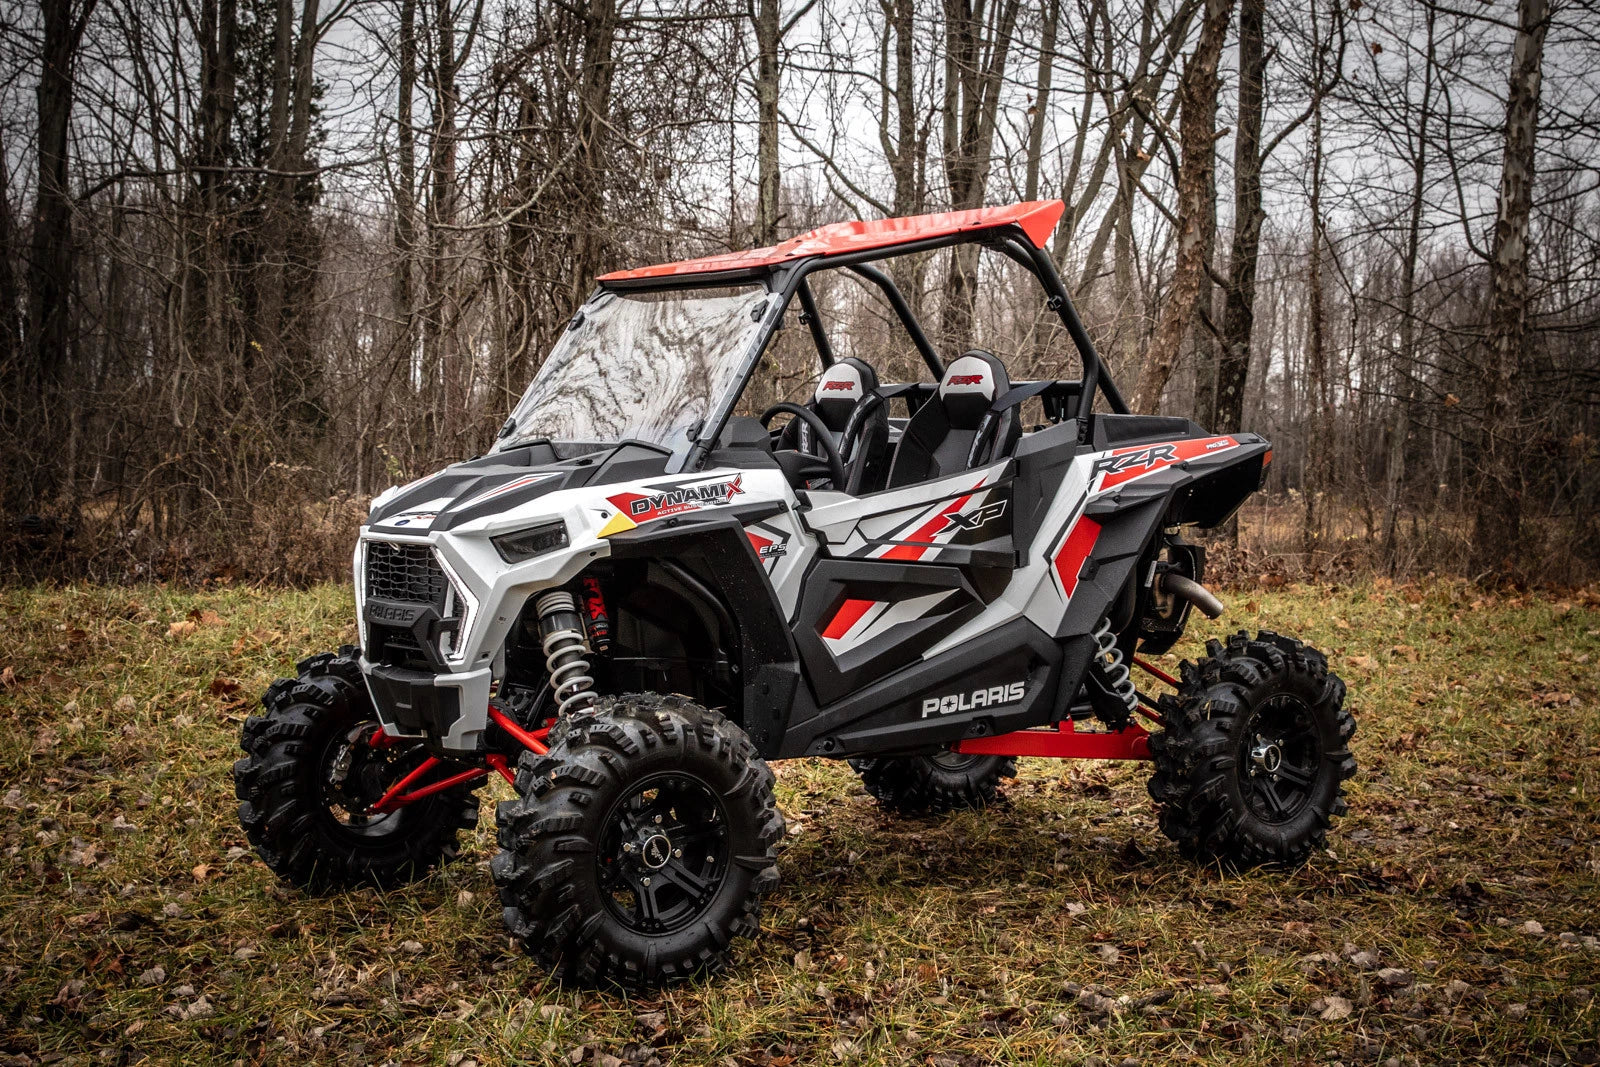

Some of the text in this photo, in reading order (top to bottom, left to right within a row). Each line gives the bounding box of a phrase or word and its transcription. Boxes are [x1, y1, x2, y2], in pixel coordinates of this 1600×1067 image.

[1087, 443, 1180, 484] RZR
[630, 473, 745, 515] DYNAMIX
[657, 506, 683, 516] ACTIVE
[929, 499, 1008, 537] XP
[759, 543, 787, 554] EPS
[921, 681, 1026, 718] POLARIS
